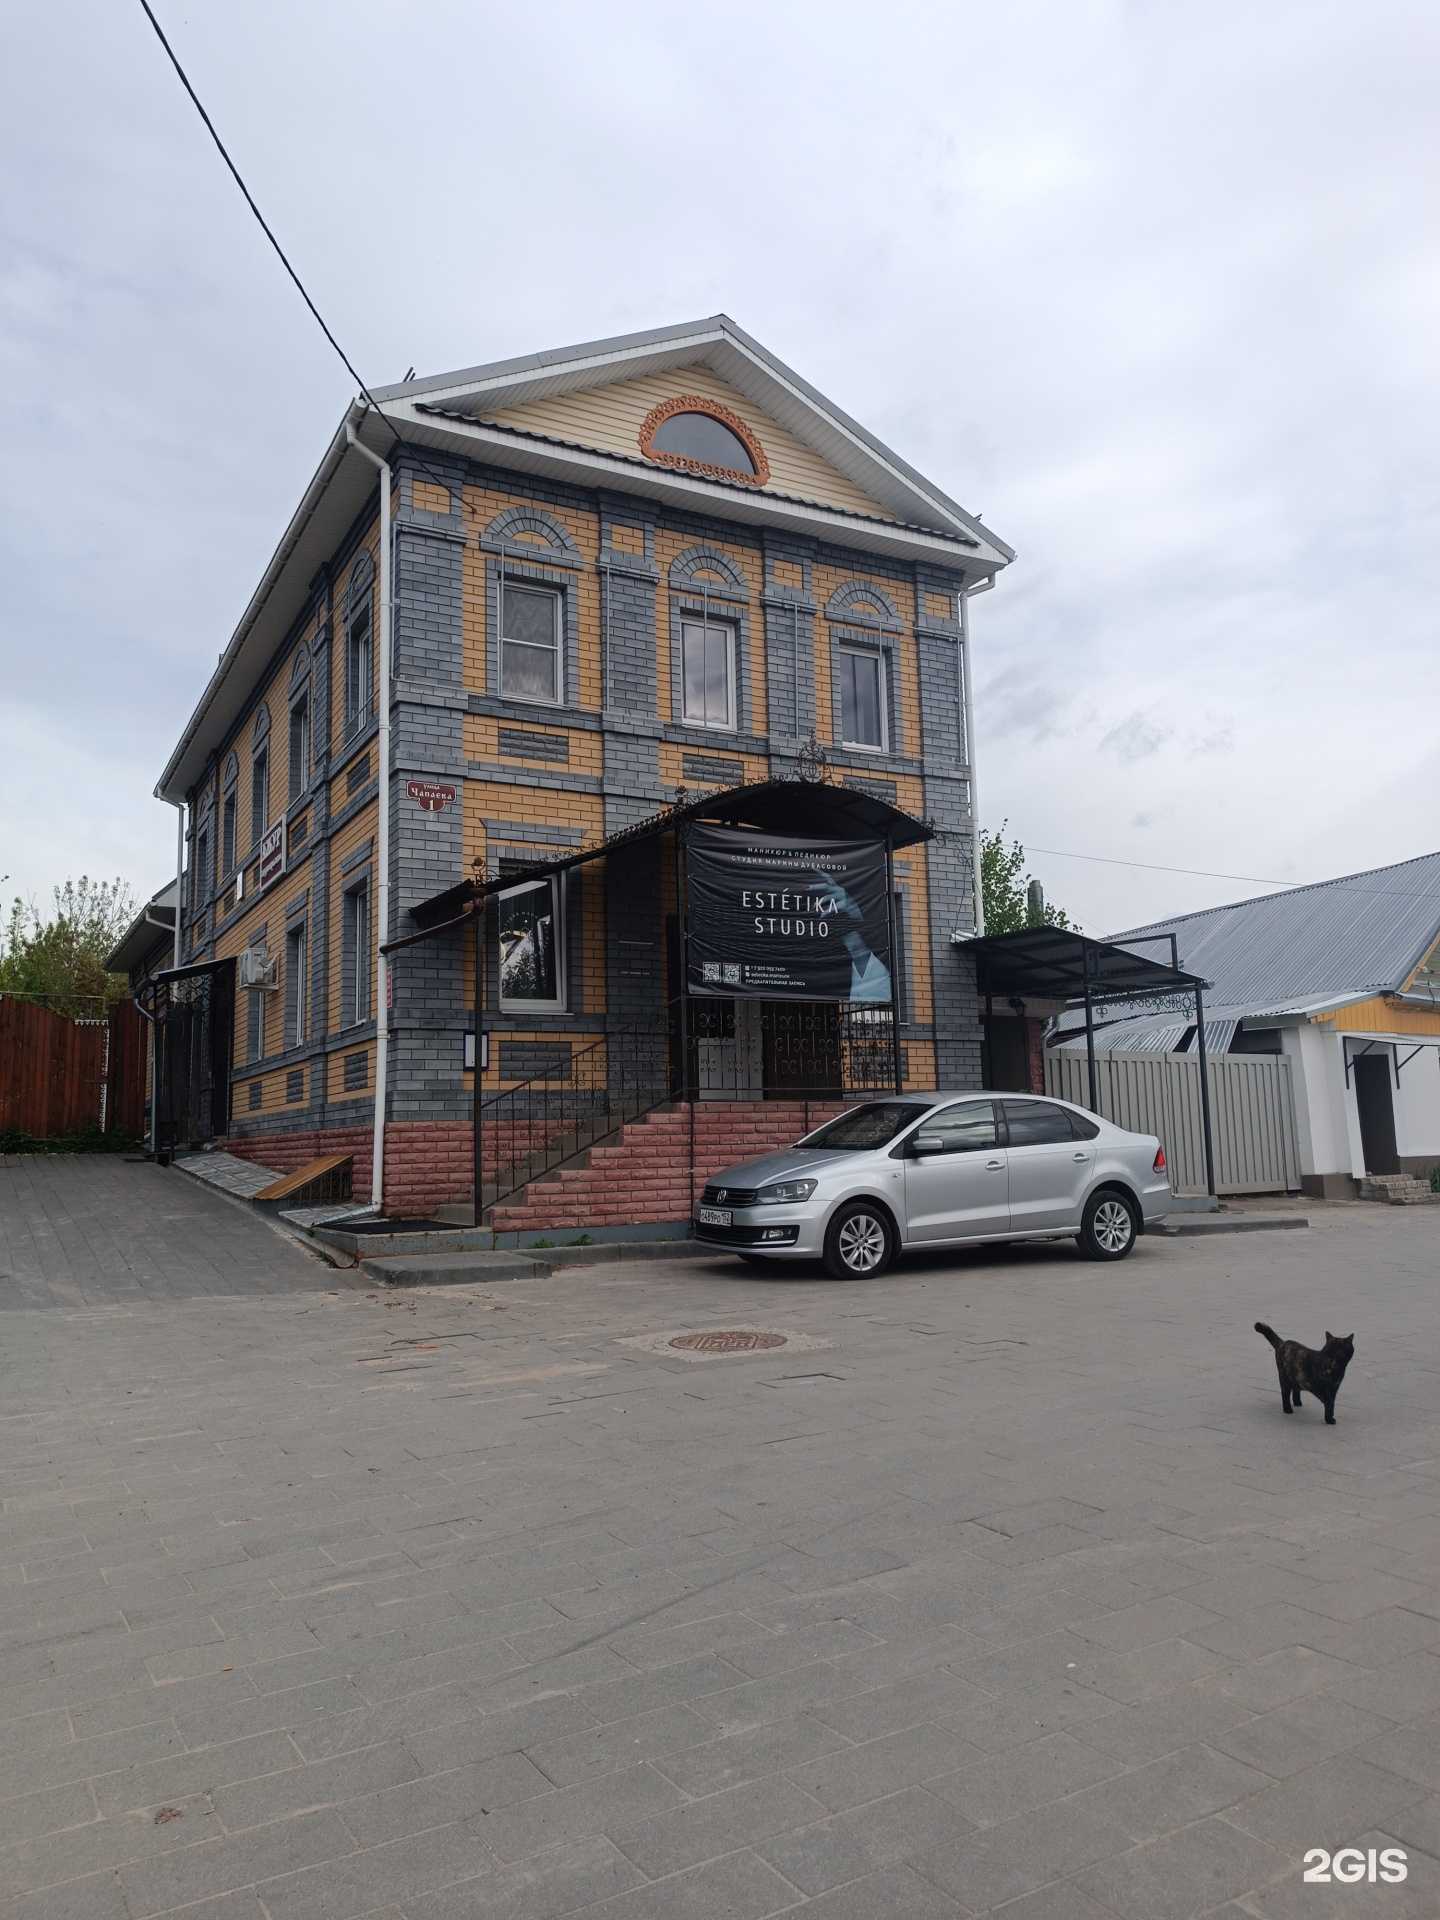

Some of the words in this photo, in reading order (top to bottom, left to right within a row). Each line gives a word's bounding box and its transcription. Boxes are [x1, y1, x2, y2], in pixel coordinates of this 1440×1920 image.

[411, 787, 452, 800] Чапаева
[430, 800, 434, 810] 1
[748, 848, 785, 856] МАНИКЮР
[795, 851, 830, 860] ПЕДИКЮР
[731, 855, 762, 864] СТУДИЯ
[766, 858, 798, 867] МАРИНЫ
[743, 888, 838, 913] ESTÉTIKA
[755, 917, 828, 937] STUDIO
